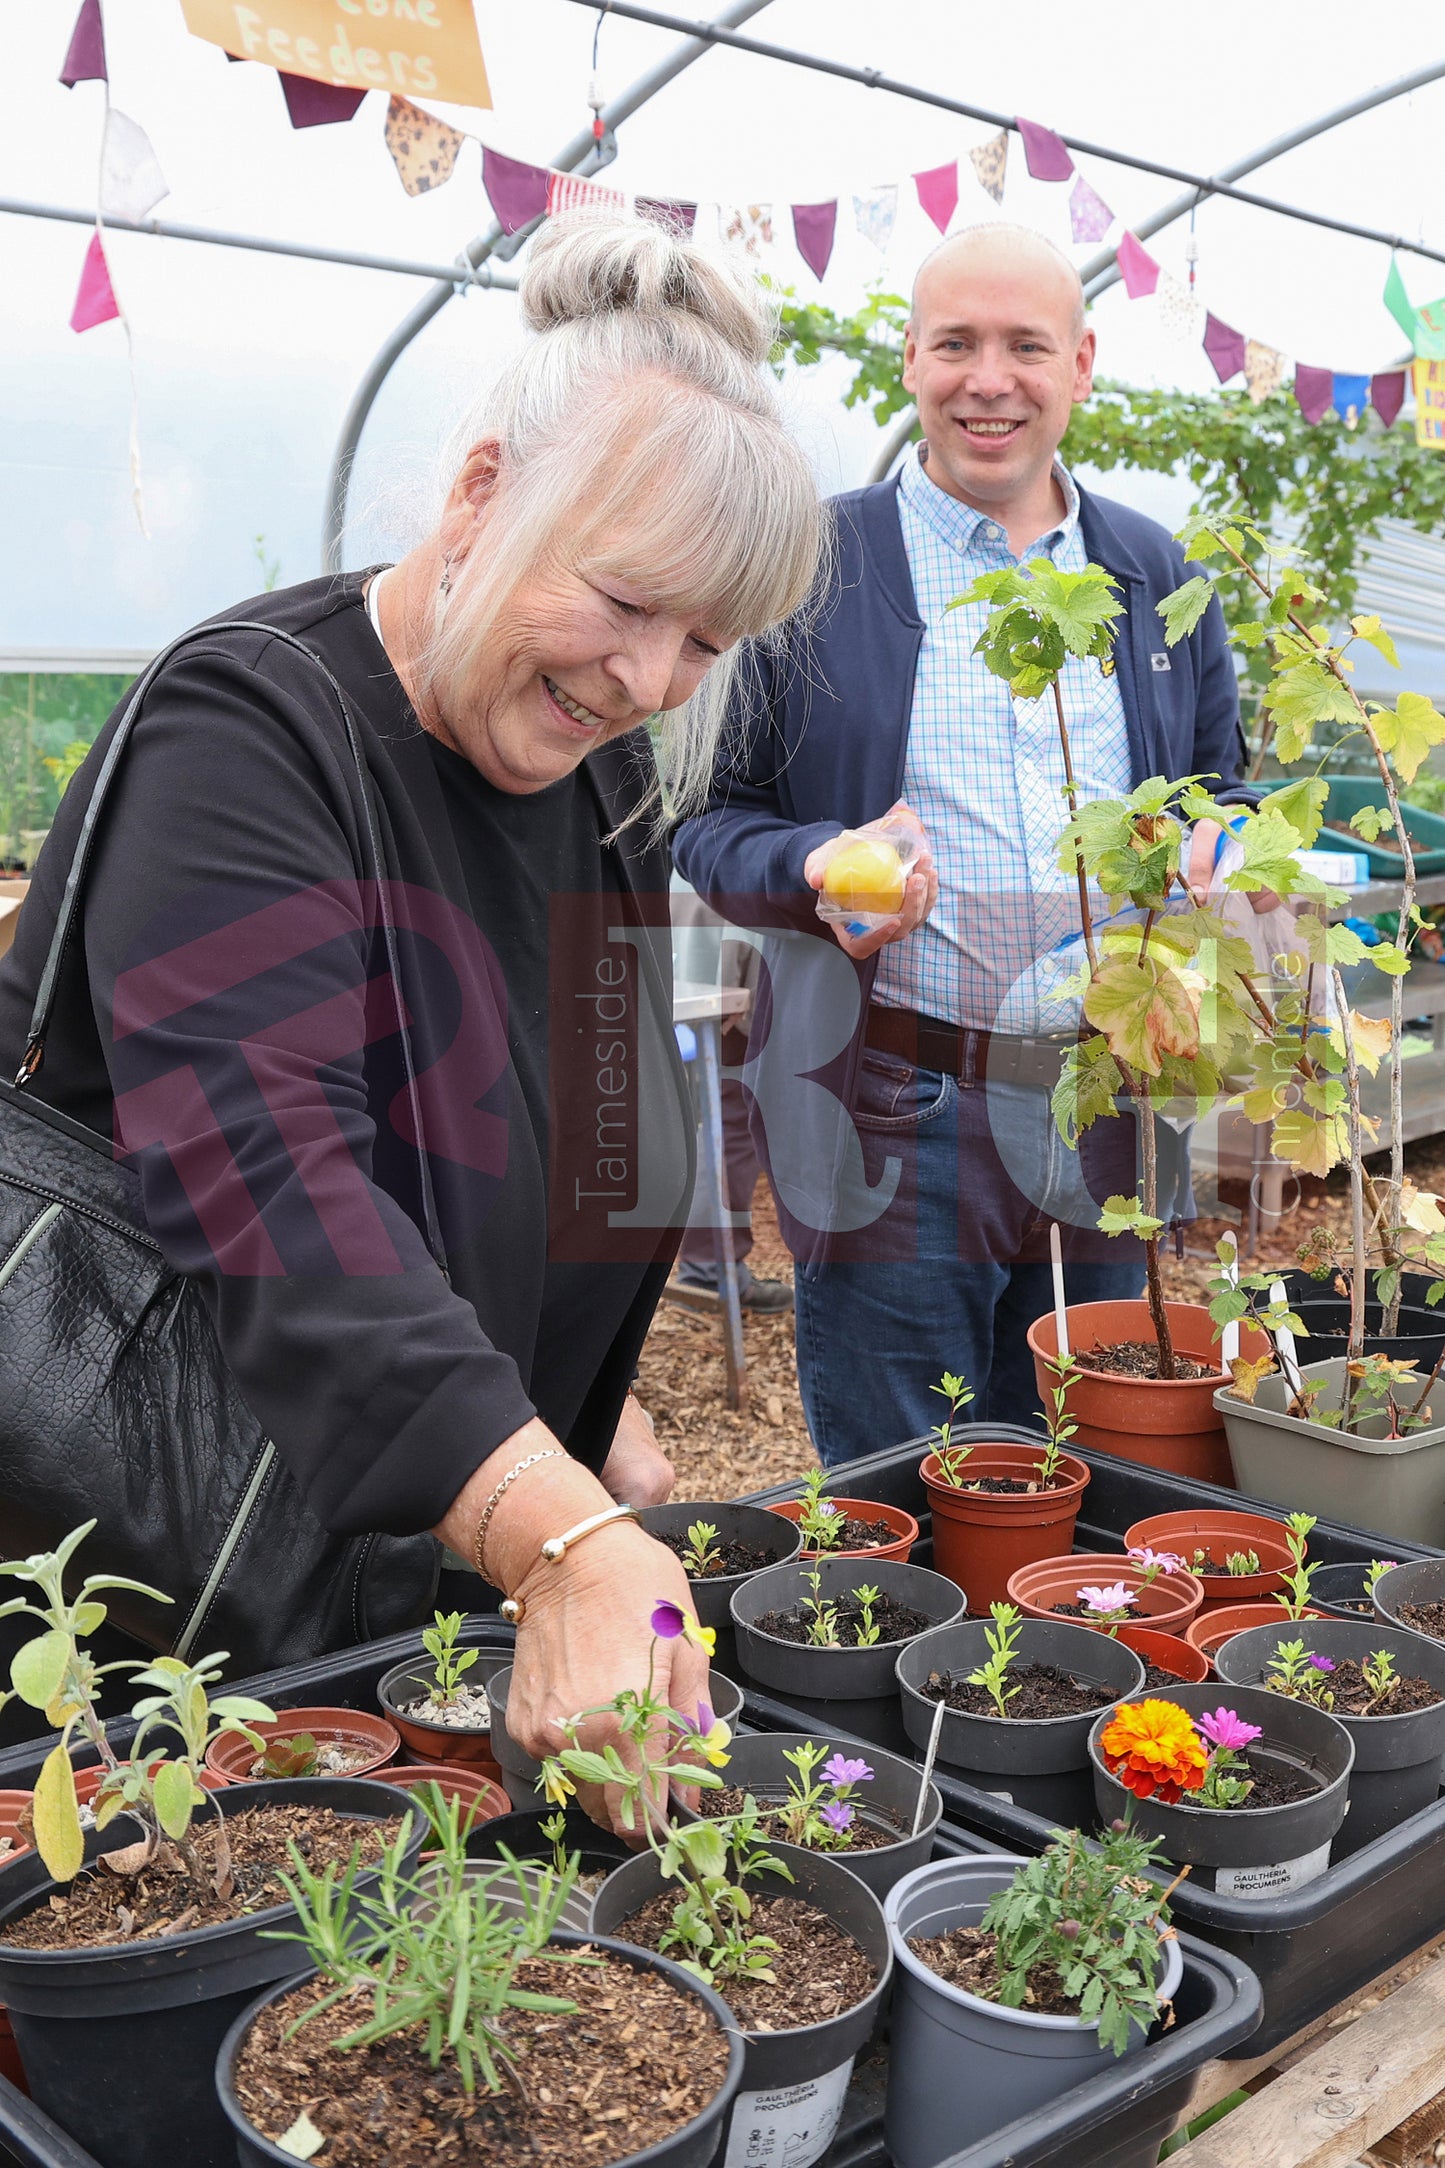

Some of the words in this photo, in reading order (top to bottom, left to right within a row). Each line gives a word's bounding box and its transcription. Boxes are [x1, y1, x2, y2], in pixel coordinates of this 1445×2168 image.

[233, 4, 438, 91] Feeders
[1233, 1868, 1287, 1882] GAULTHERIA
[1233, 1875, 1291, 1891] PROCUMBENS
[756, 2083, 815, 2104] GAULTHERIA
